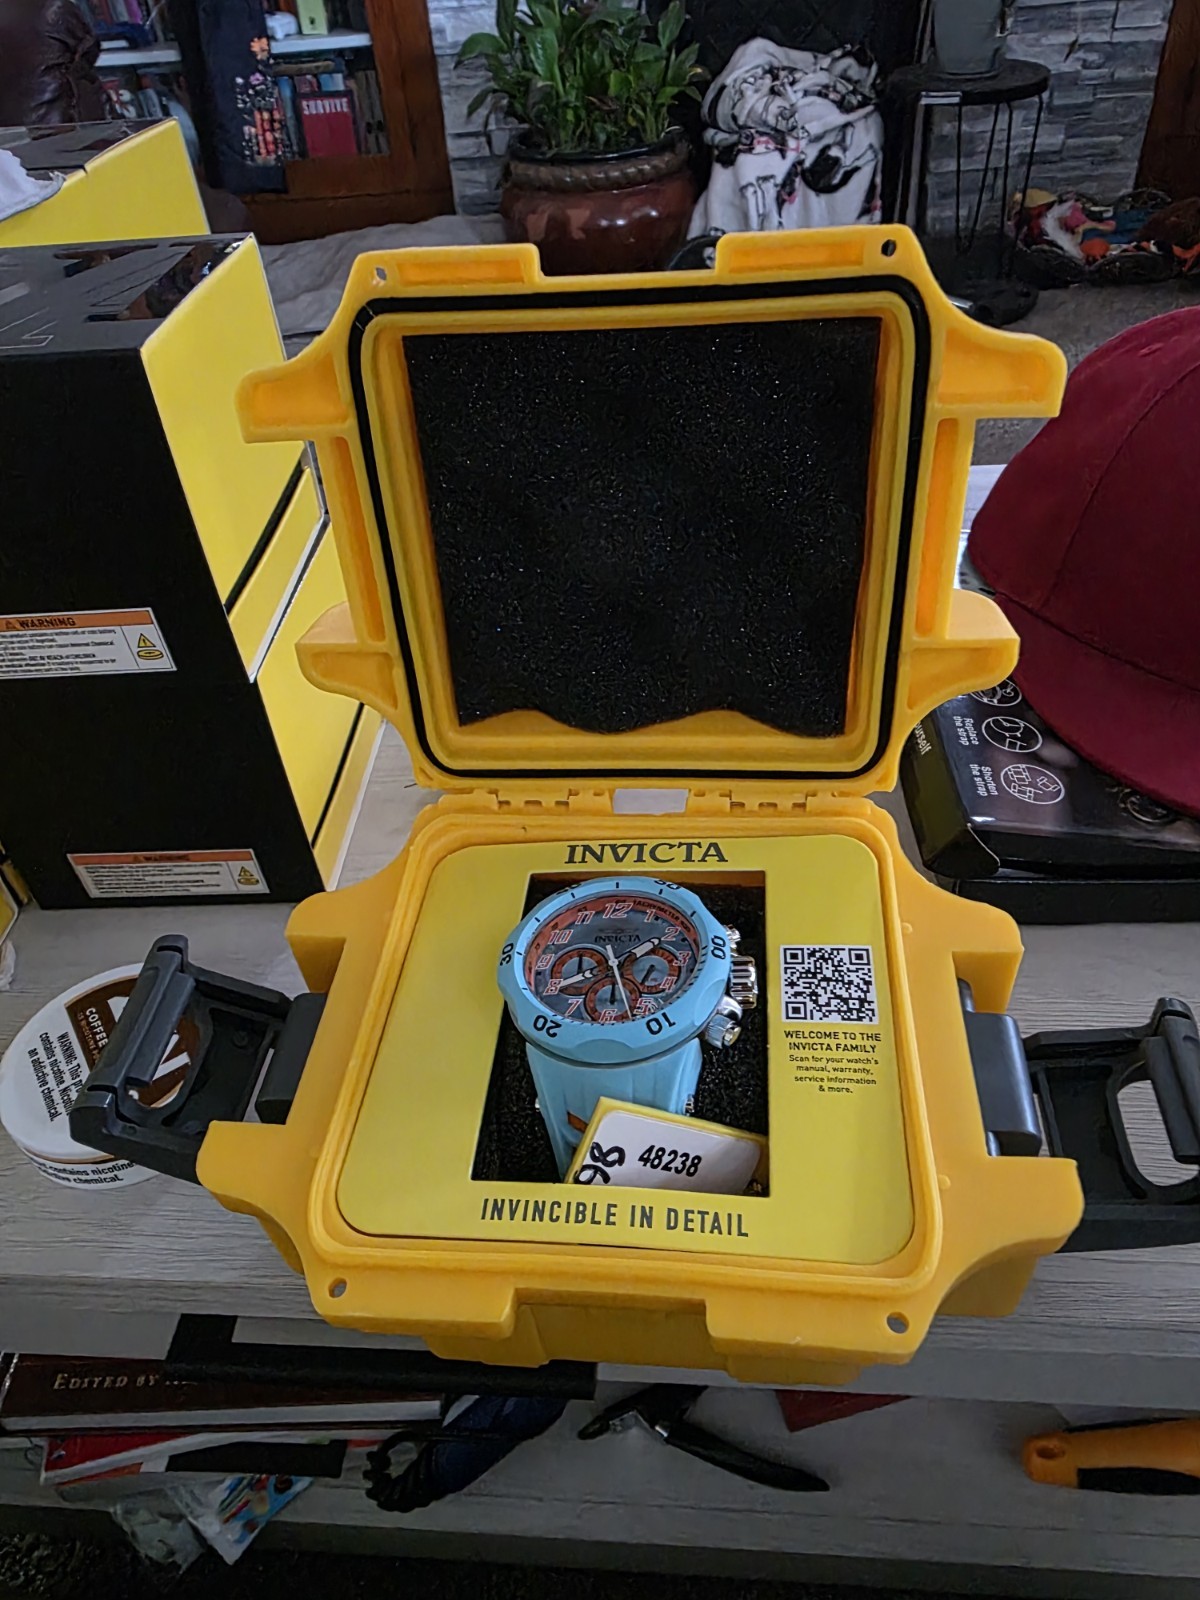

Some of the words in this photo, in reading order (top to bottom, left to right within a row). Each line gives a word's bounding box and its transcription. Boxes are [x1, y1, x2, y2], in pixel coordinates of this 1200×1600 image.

[19, 616, 77, 630] WARNING
[953, 715, 964, 727] the
[957, 728, 970, 746] strap
[963, 717, 979, 745] Replace
[969, 764, 981, 776] the
[974, 777, 988, 797] strap
[981, 766, 999, 796] Shorten
[564, 842, 728, 864] INVICTA
[574, 910, 596, 925] 11
[602, 903, 634, 918] 12
[644, 908, 656, 922] 1
[548, 929, 574, 945] 10
[594, 934, 642, 944] INVICTA
[661, 926, 681, 941] 2
[500, 943, 514, 967] 30
[535, 954, 555, 970] 9
[673, 951, 691, 967] 3
[543, 979, 564, 996] 8
[660, 976, 677, 993] 4
[565, 999, 583, 1017] 7
[633, 998, 655, 1016] 5
[599, 1008, 618, 1024] 6
[645, 1011, 676, 1036] 10
[86, 1007, 109, 1049] COFFEE
[533, 1014, 562, 1038] 20
[784, 1030, 840, 1040] WELCOME
[842, 1031, 857, 1041] TO
[859, 1032, 882, 1042] THE
[28, 1047, 39, 1059] an
[788, 1041, 833, 1052] INVICTA
[835, 1043, 877, 1053] FAMILY
[39, 1032, 56, 1060] contains
[48, 1059, 66, 1089] nicotine.
[57, 1031, 78, 1067] WARNING:
[68, 1063, 82, 1081] This
[789, 1055, 810, 1063] Scan
[811, 1055, 824, 1063] for
[826, 1056, 845, 1065] your
[846, 1056, 879, 1065] watch's
[31, 1057, 49, 1088] addictive
[796, 1064, 830, 1073] manual,
[831, 1067, 874, 1076] warranty,
[826, 1075, 877, 1085] information
[818, 1084, 826, 1092] &
[827, 1086, 853, 1094] more.
[40, 1086, 62, 1122] chemical.
[573, 1141, 626, 1185] 98
[637, 1144, 703, 1178] 48238
[480, 1198, 618, 1227] INVINCIBLE
[629, 1204, 654, 1229] IN
[666, 1207, 750, 1238] DETAIL
